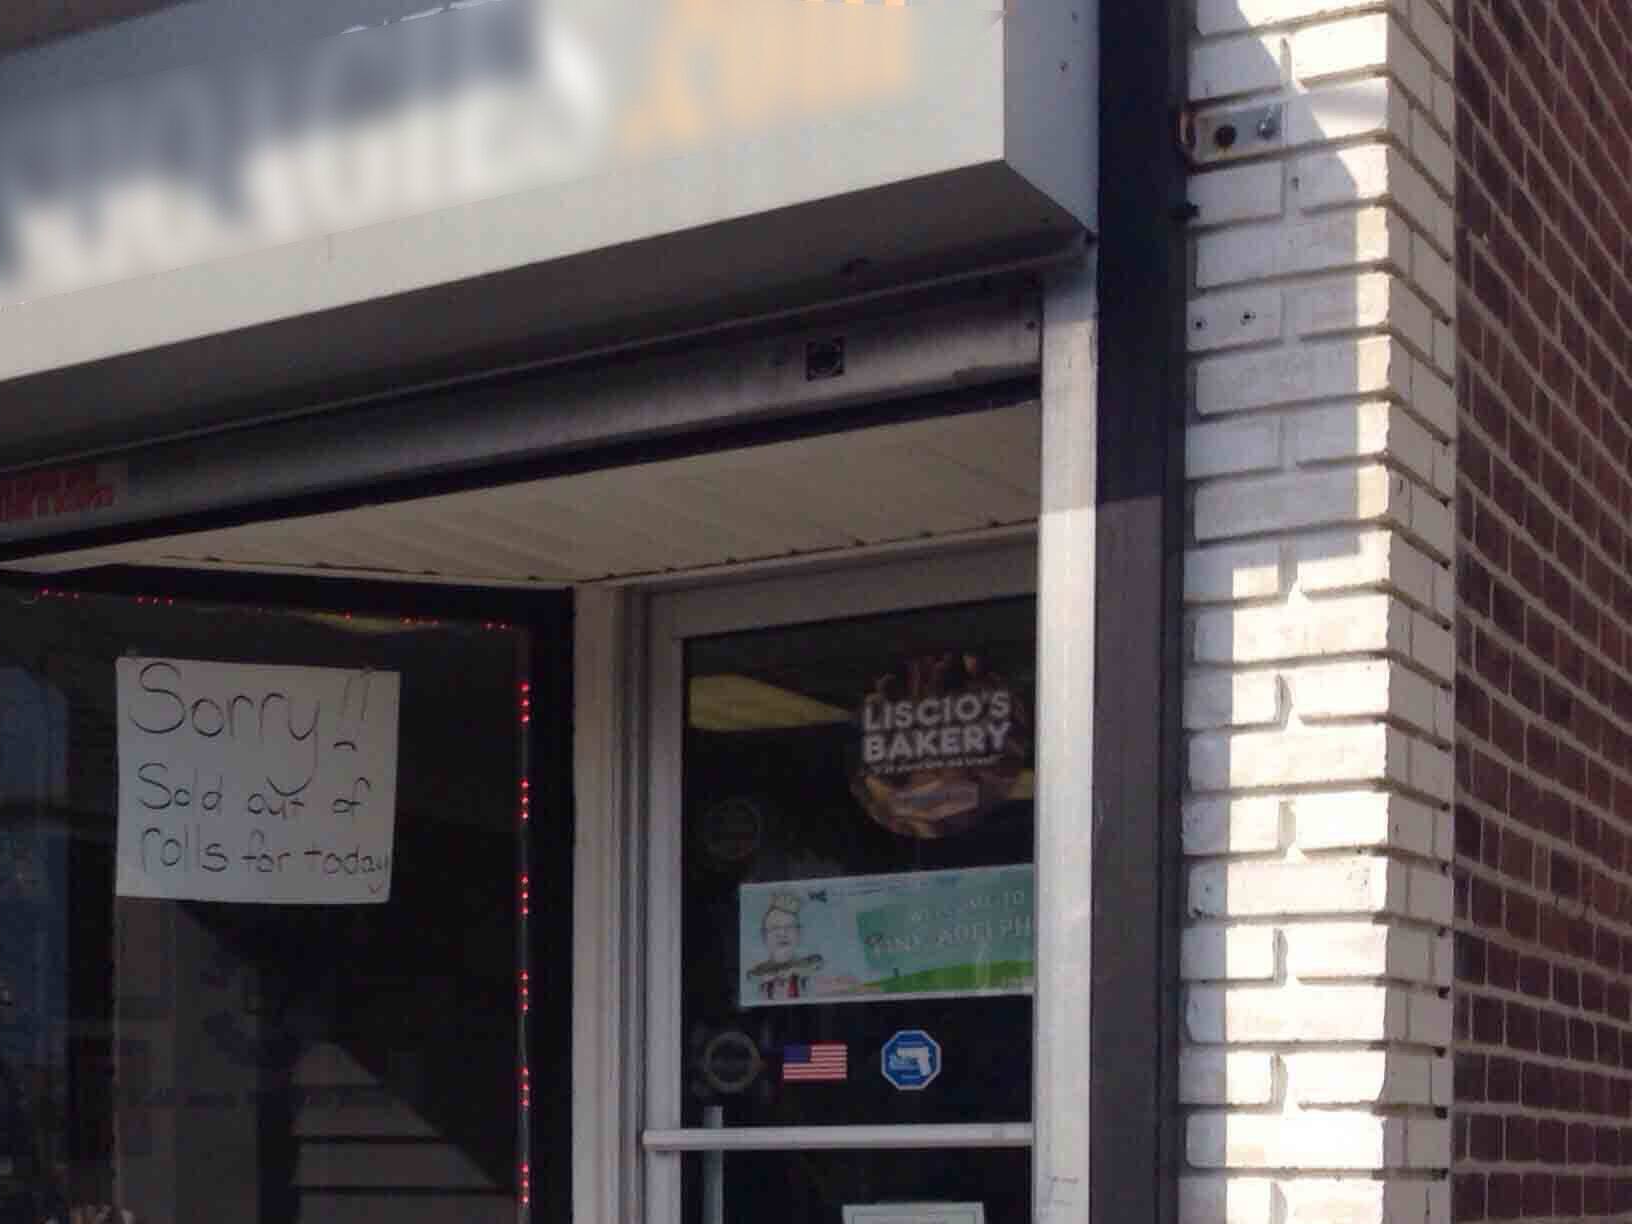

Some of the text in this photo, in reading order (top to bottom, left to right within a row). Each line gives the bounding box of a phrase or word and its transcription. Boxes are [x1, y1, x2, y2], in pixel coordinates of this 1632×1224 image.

[862, 691, 1011, 731] LISCIO'S
[862, 722, 1013, 763] BAKERY
[138, 762, 223, 810] Sold
